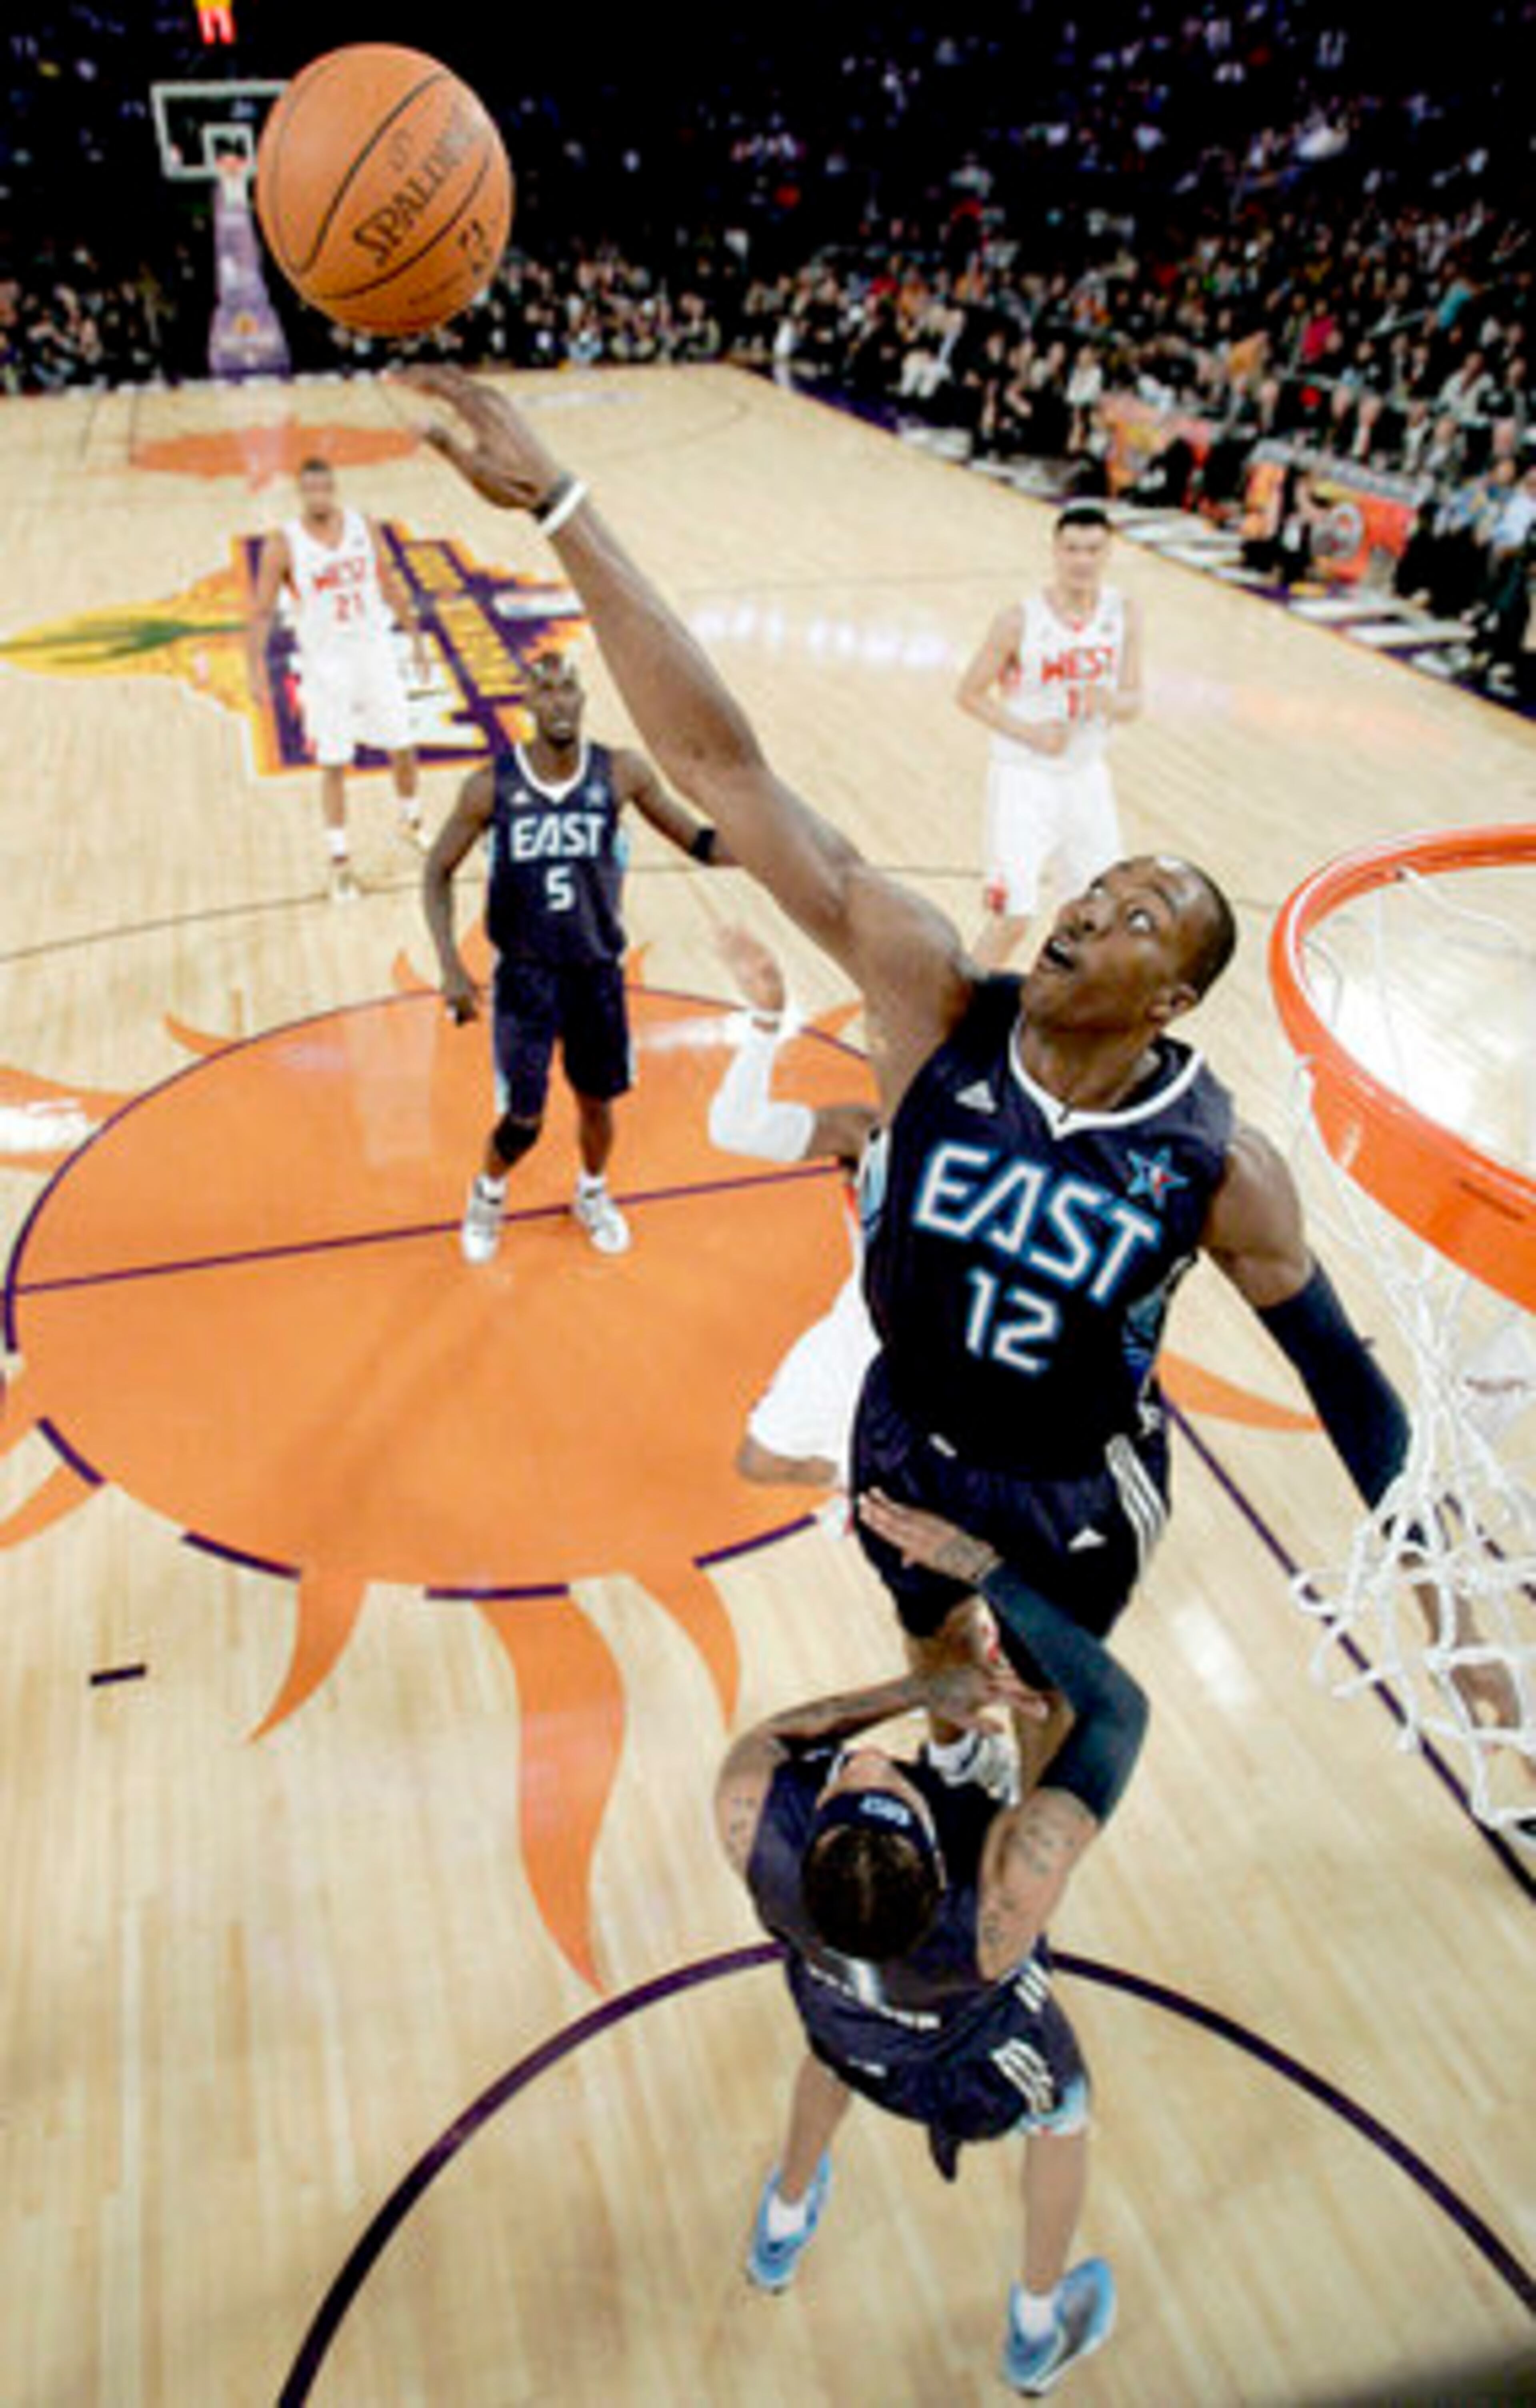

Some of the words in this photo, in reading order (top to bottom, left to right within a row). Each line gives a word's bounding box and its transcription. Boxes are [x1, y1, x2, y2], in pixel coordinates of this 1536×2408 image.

[1041, 647, 1114, 685] WEST
[511, 813, 606, 862] EAST
[546, 866, 575, 911] 5
[914, 1140, 1161, 1304] EAST
[966, 1269, 1060, 1376] 12
